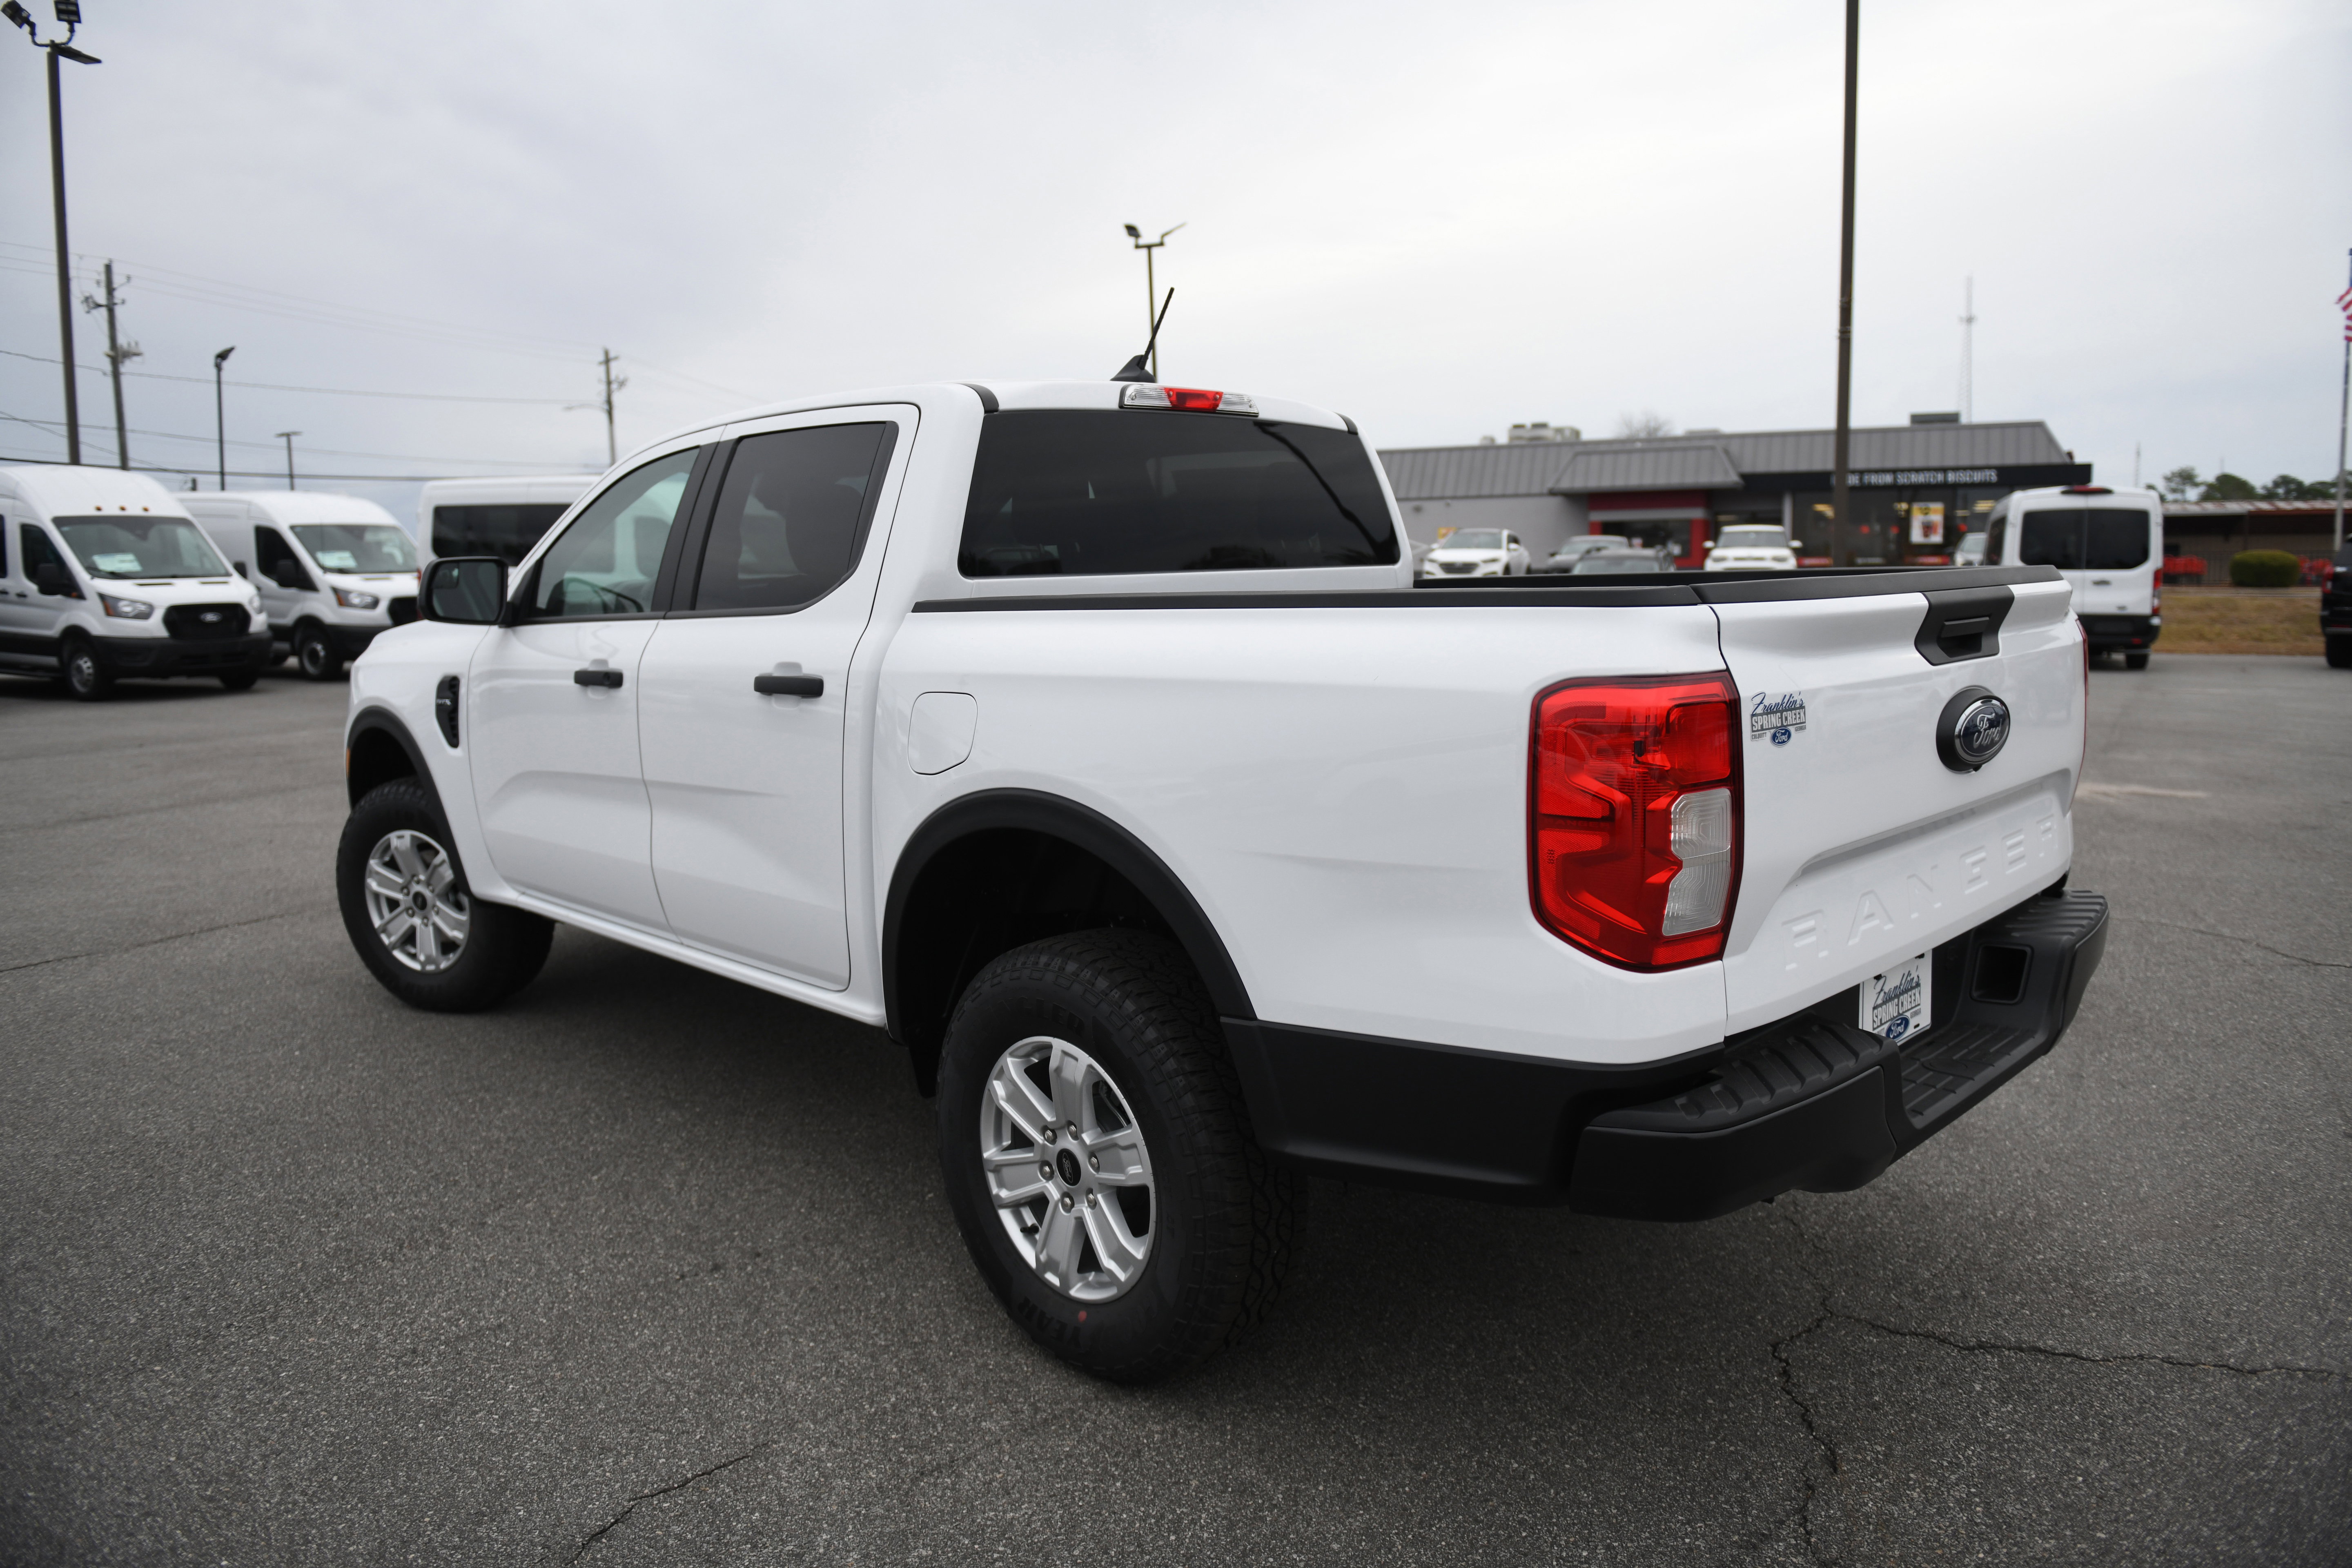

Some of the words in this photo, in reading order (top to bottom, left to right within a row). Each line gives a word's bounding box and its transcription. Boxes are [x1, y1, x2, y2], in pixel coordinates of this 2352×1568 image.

[1862, 472, 1894, 486] FROM
[1895, 471, 1944, 486] SCRATCH
[1946, 469, 1998, 484] BISCUITS
[1751, 691, 1804, 715] Franklin's
[1752, 713, 1781, 731] SPRING
[1782, 708, 1805, 726] CREEK
[1973, 713, 2002, 748] Ford
[1775, 730, 1788, 743] Ford
[1781, 814, 2059, 970] RANGER
[1873, 965, 1921, 1009] Franklin's
[1873, 998, 1898, 1029] SPRING
[1899, 987, 1920, 1013] CREEK
[1890, 1019, 1905, 1038] Ford
[1063, 1158, 1071, 1178] Ford
